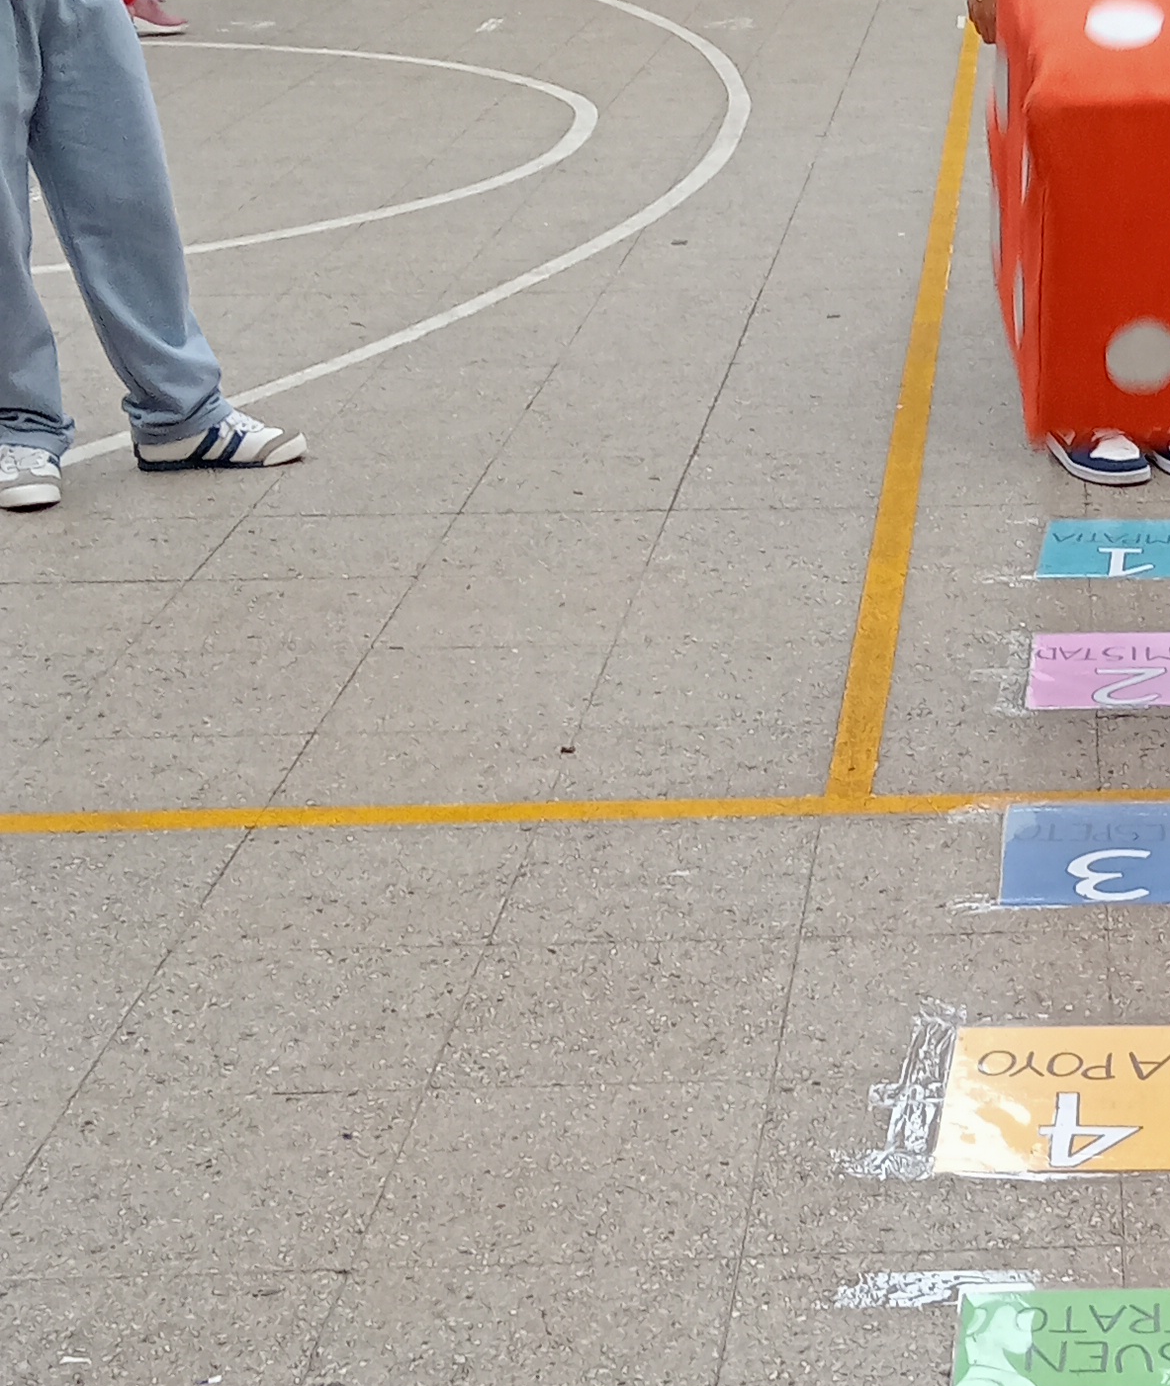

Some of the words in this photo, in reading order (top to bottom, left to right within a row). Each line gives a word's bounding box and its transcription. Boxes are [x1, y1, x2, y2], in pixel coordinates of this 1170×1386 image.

[1097, 547, 1156, 577] 1
[1091, 667, 1167, 706] 2
[1065, 847, 1151, 902] 3
[1037, 1091, 1144, 1168] 4
